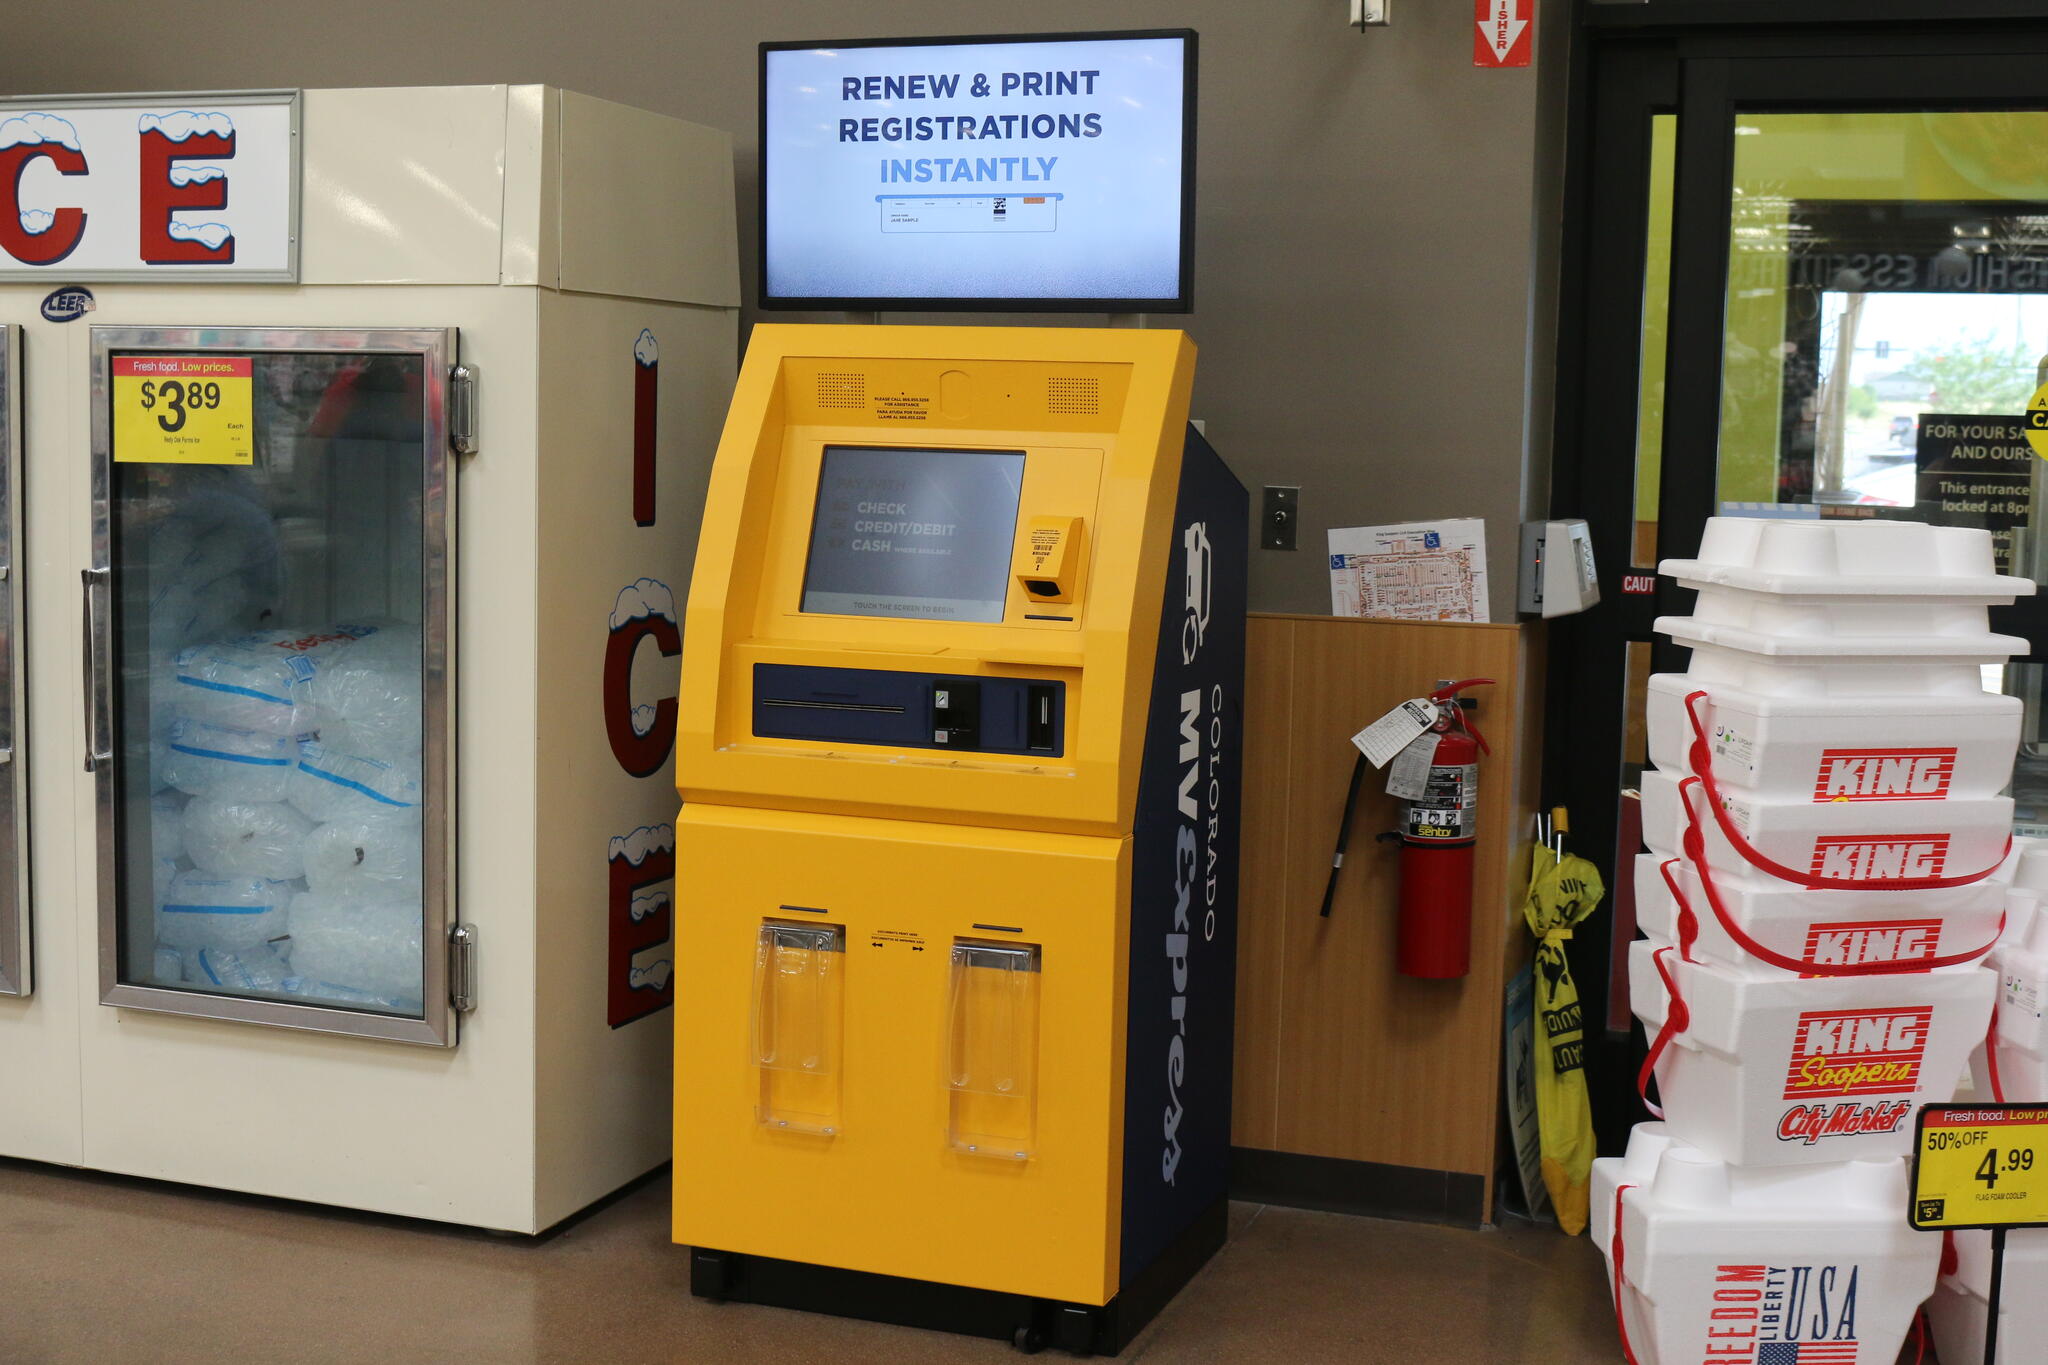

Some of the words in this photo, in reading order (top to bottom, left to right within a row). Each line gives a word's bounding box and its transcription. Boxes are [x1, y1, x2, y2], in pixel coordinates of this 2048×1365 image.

[842, 74, 960, 100] RENEW
[970, 72, 991, 98] &
[1001, 70, 1100, 96] PRINT
[839, 113, 1103, 142] REGISTRATIONS
[880, 157, 1058, 183] INSTANTLY
[48, 295, 86, 313] LEER
[133, 361, 156, 371] Fresh
[159, 362, 180, 372] food.
[182, 362, 200, 372] Low
[203, 363, 235, 374] prices.
[1925, 424, 1956, 438] FOR
[1961, 425, 2004, 439] YOUR
[1951, 445, 1987, 459] AND
[1939, 481, 1967, 494] This
[1969, 482, 2030, 496] entrance
[857, 501, 907, 516] CHECK
[1942, 500, 1987, 513] locked
[1990, 502, 2004, 513] at
[854, 519, 956, 537] CREDIT/DEBIT
[852, 538, 892, 552] CASH
[854, 601, 877, 609] TOUCH
[879, 602, 892, 610] THE
[894, 603, 920, 612] SCREEN
[1826, 757, 1941, 796] KING
[1204, 683, 1222, 942] COLORADO
[1820, 843, 1935, 880] KING
[1813, 928, 1927, 966] KING
[1803, 1016, 1917, 1056] KING
[1795, 1056, 1913, 1092] Soopers
[1944, 1111, 1975, 1122] Fresh
[1978, 1110, 2006, 1121] food.
[2009, 1110, 2034, 1120] Low
[1975, 1193, 1990, 1201] FLAG
[1990, 1192, 2005, 1200] FOAM
[2005, 1191, 2027, 1200] COOLER
[1758, 1266, 1787, 1341] LIBERTY
[1785, 1265, 1859, 1341] USA
